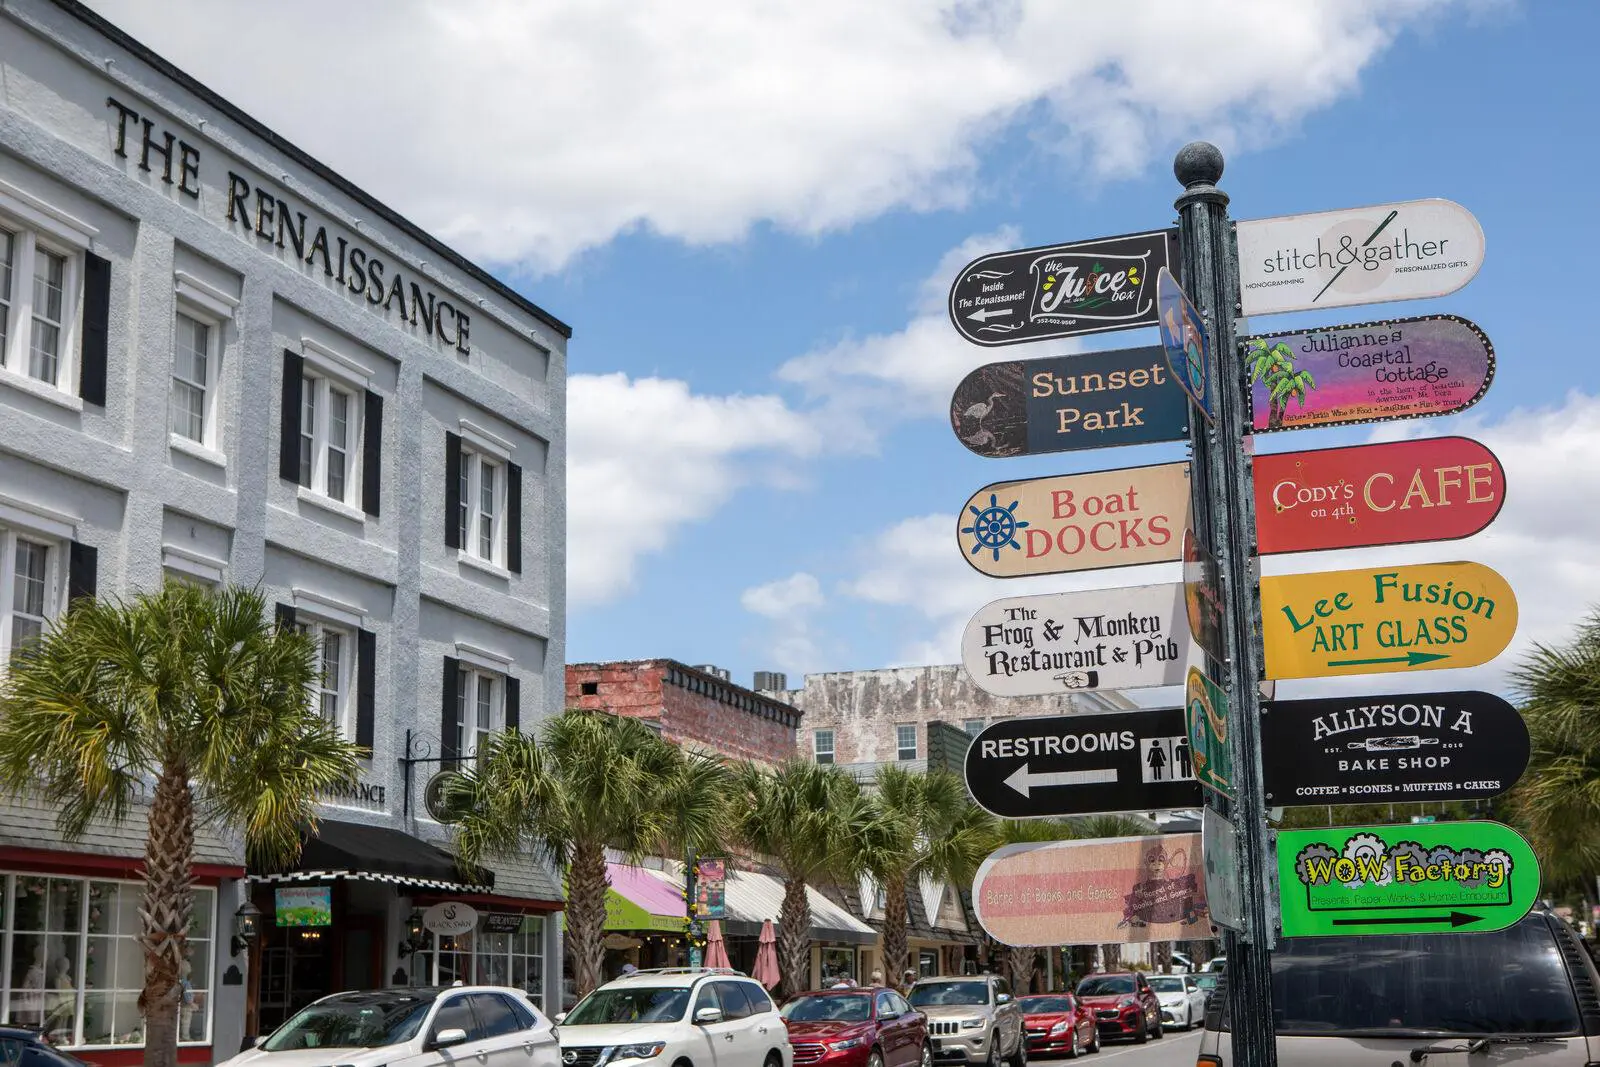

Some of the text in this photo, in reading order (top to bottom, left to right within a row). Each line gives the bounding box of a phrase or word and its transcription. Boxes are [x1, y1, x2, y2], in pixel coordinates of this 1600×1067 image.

[107, 97, 471, 356] THE RENAISSANCE
[1044, 260, 1064, 272] the
[1395, 260, 1468, 274] PERSONALIZED GIFTS
[982, 282, 1005, 293] Inside
[1245, 278, 1305, 290] MONOGRAMMING
[958, 290, 1026, 309] The Renaissance!
[1112, 288, 1136, 302] box
[1301, 326, 1403, 353] Julianne's
[1338, 346, 1413, 368] Coastal
[1031, 363, 1166, 398] Sunset
[1376, 361, 1449, 384] Cottage
[1396, 386, 1416, 394] heart
[1432, 380, 1465, 391] beautiful
[1376, 394, 1413, 404] downtown
[1056, 402, 1145, 434] Park
[1356, 407, 1372, 415] Food
[1363, 462, 1495, 512] CAFE
[1050, 484, 1140, 520] Boat
[1310, 502, 1355, 520] on 4th
[1025, 515, 1171, 558] DOCKS
[1281, 572, 1496, 634] Lee Fusion
[1004, 607, 1038, 622] The
[981, 612, 1163, 649] Frog & Monkey
[1312, 616, 1468, 652] ART GLASS
[985, 638, 1179, 676] Restaurant & Pub
[1312, 704, 1474, 741] ALLYSON A
[981, 730, 1136, 759] RESTROOMS
[1338, 756, 1452, 771] BAKE SHOP
[1296, 780, 1501, 796] COFFEE SCONES MUFFINS CAKES
[1395, 852, 1505, 888] Factory
[1021, 887, 1032, 904] of
[1034, 888, 1062, 902] Books
[1066, 884, 1083, 900] and
[1088, 884, 1120, 901] Games
[1428, 892, 1457, 902] Home
[1132, 900, 1153, 910] Books
